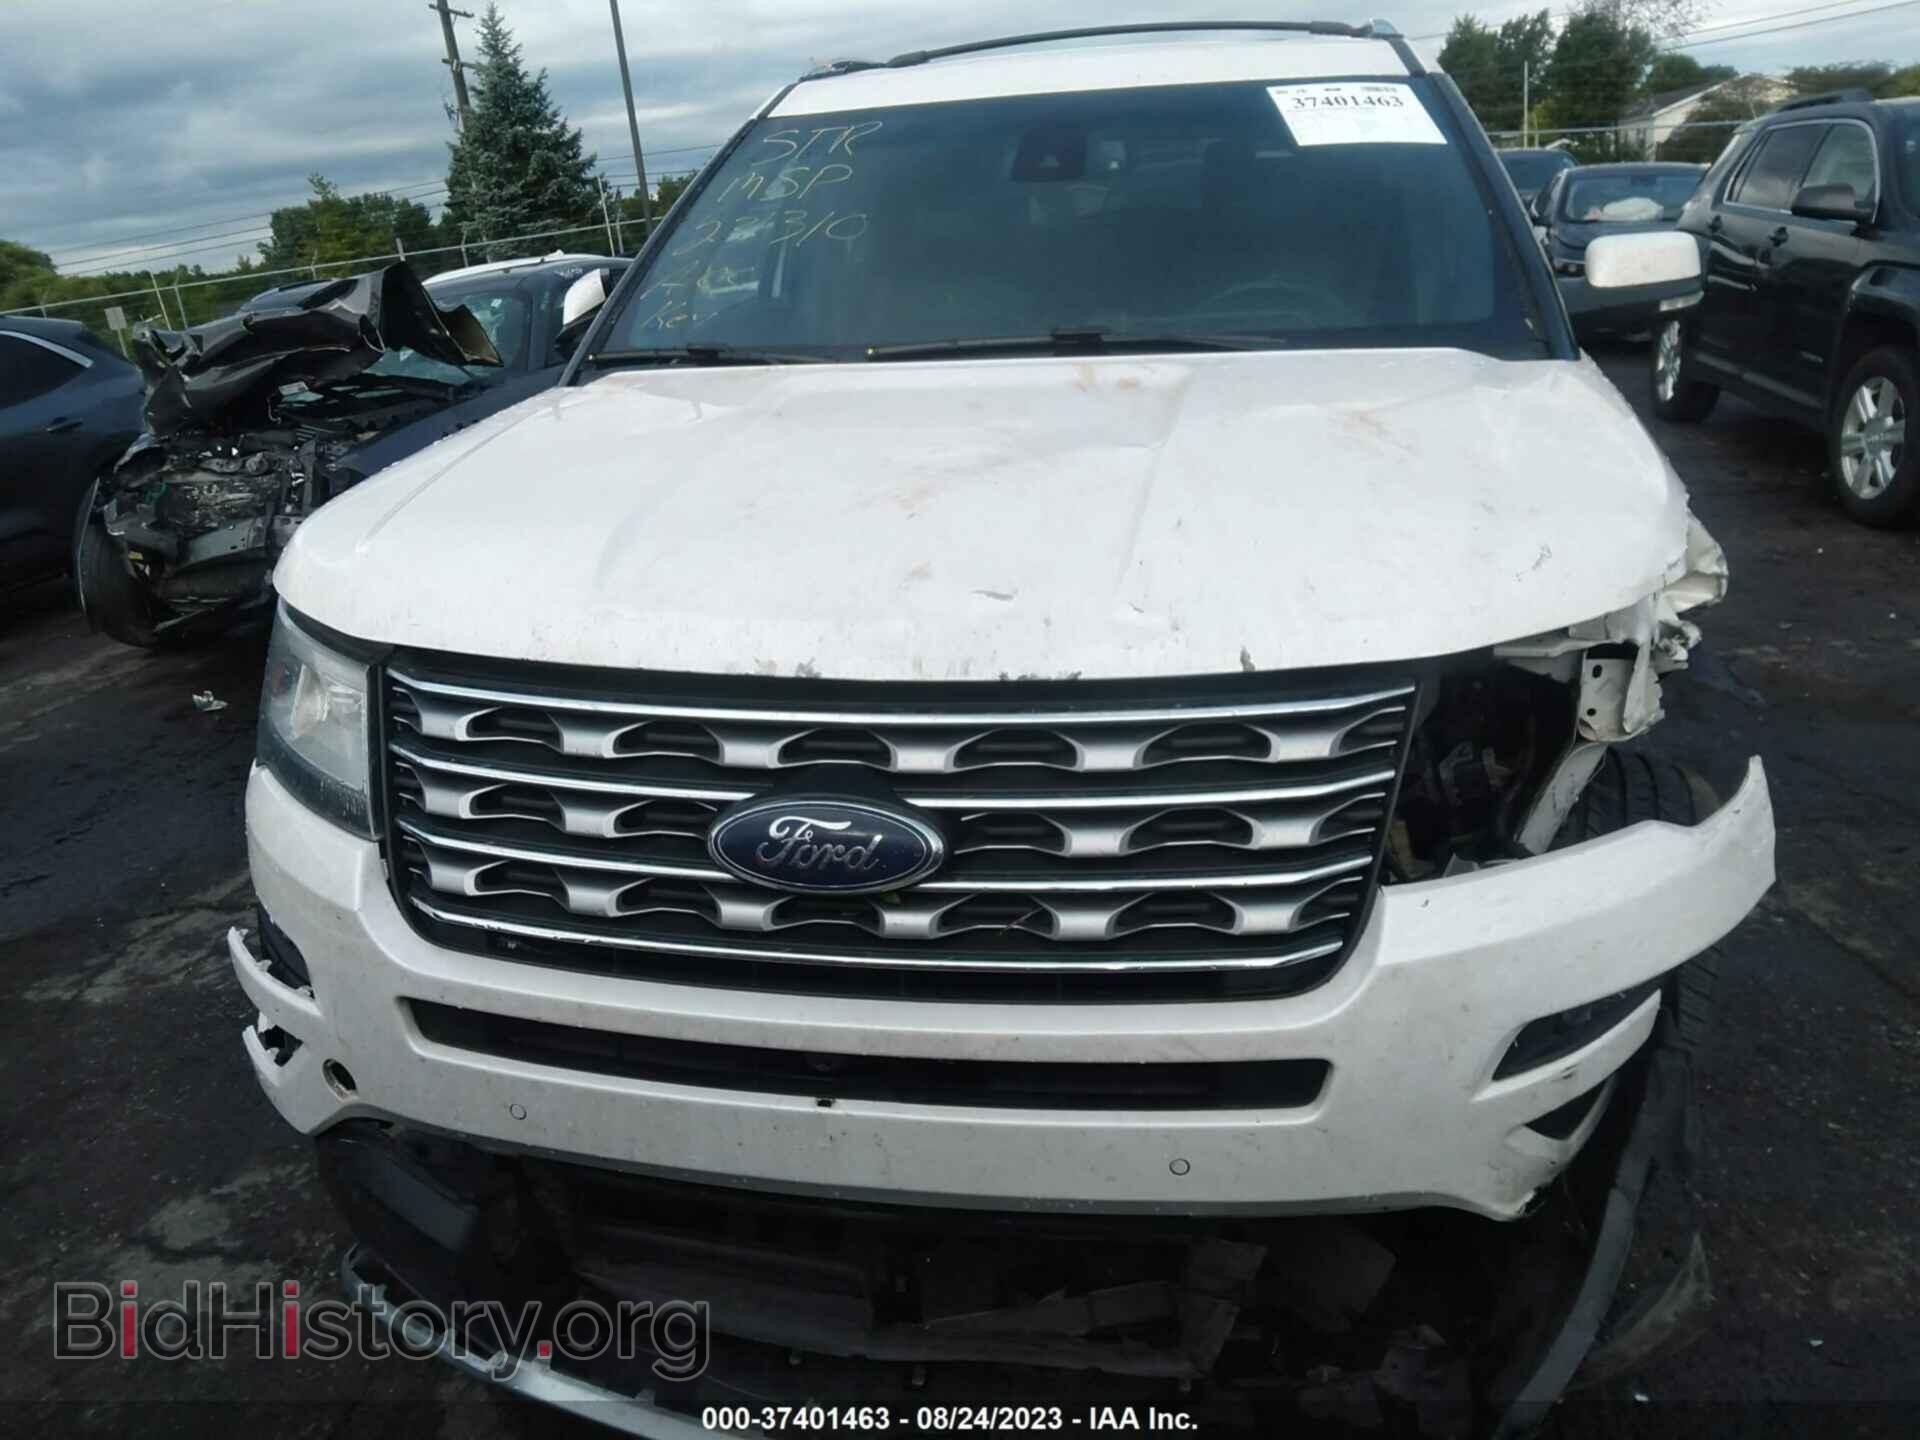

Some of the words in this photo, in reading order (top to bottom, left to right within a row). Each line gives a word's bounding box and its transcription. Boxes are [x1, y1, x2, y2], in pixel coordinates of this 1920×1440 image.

[1291, 95, 1404, 109] 37401463
[751, 120, 883, 166] STR
[756, 815, 883, 871] Ford
